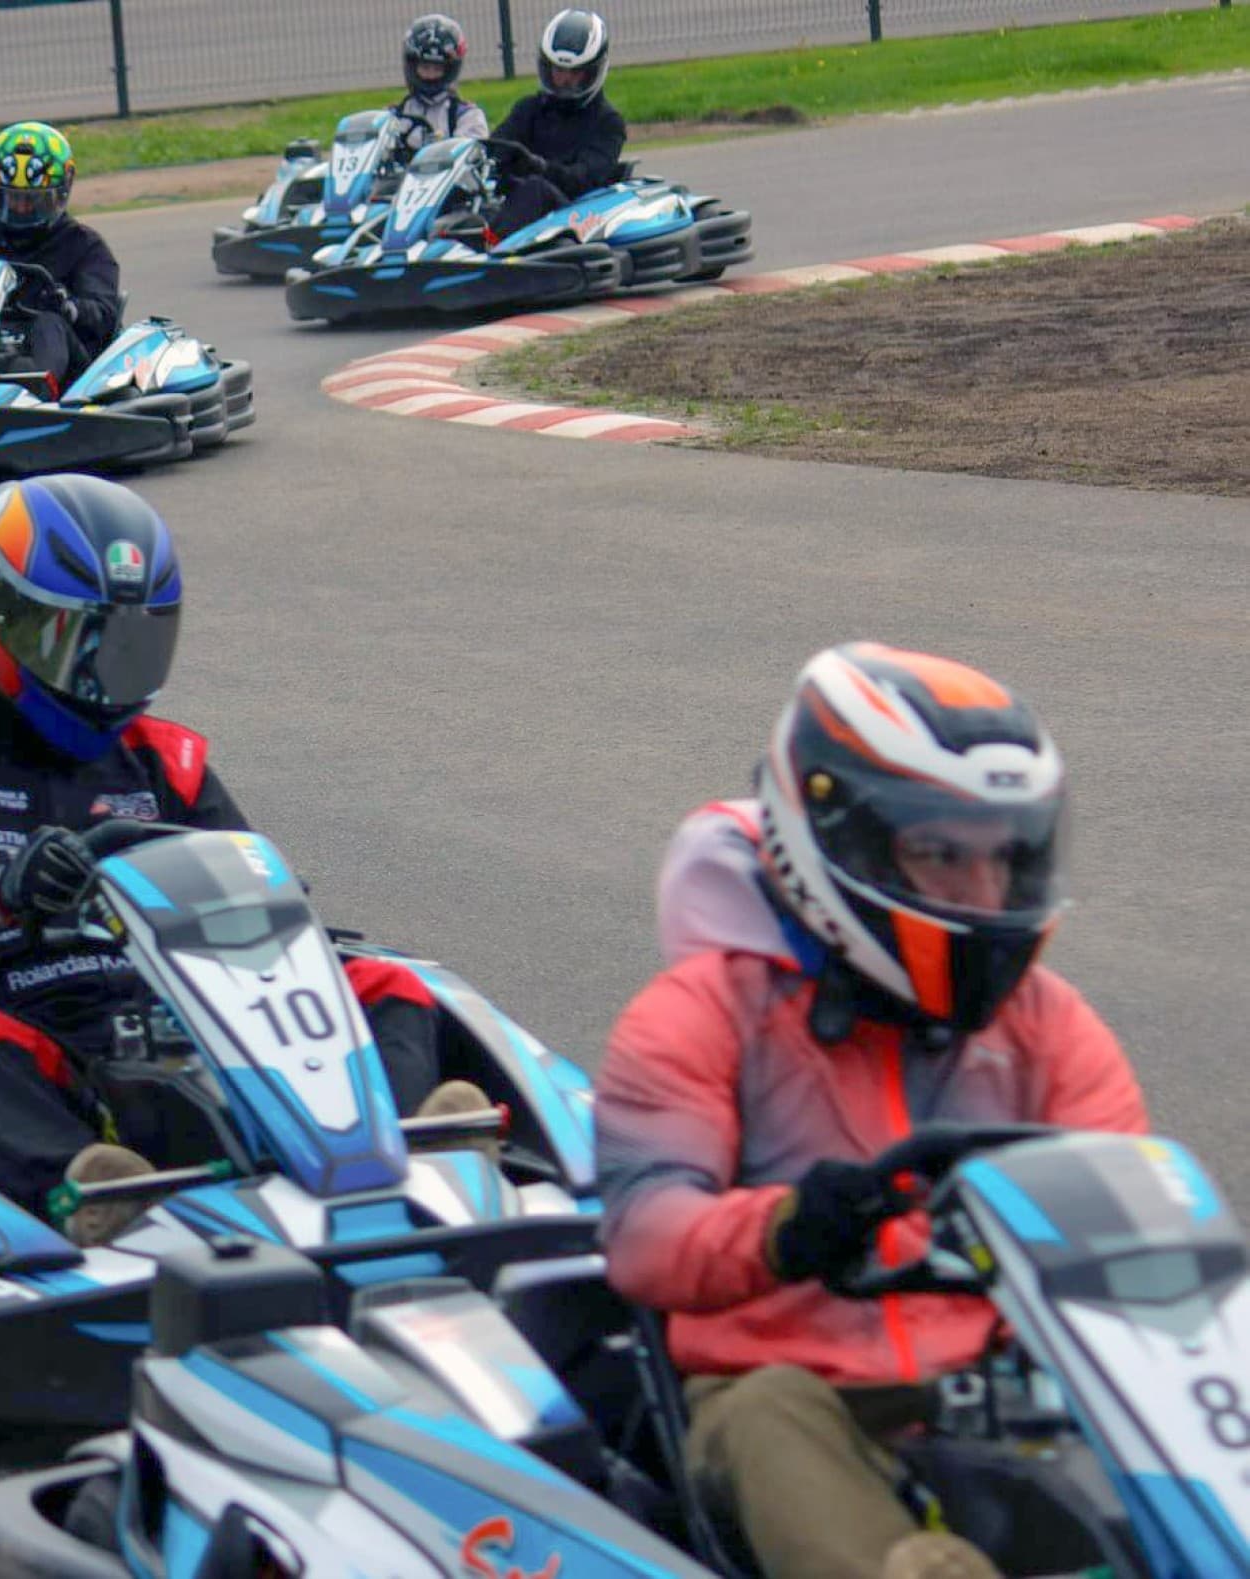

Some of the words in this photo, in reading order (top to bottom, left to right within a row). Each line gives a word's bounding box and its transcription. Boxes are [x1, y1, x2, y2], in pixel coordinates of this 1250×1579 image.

[338, 156, 359, 172] 13
[403, 187, 429, 205] 17
[7, 955, 100, 991] Rolandas
[247, 988, 336, 1046] 10
[1191, 1375, 1250, 1449] 8
